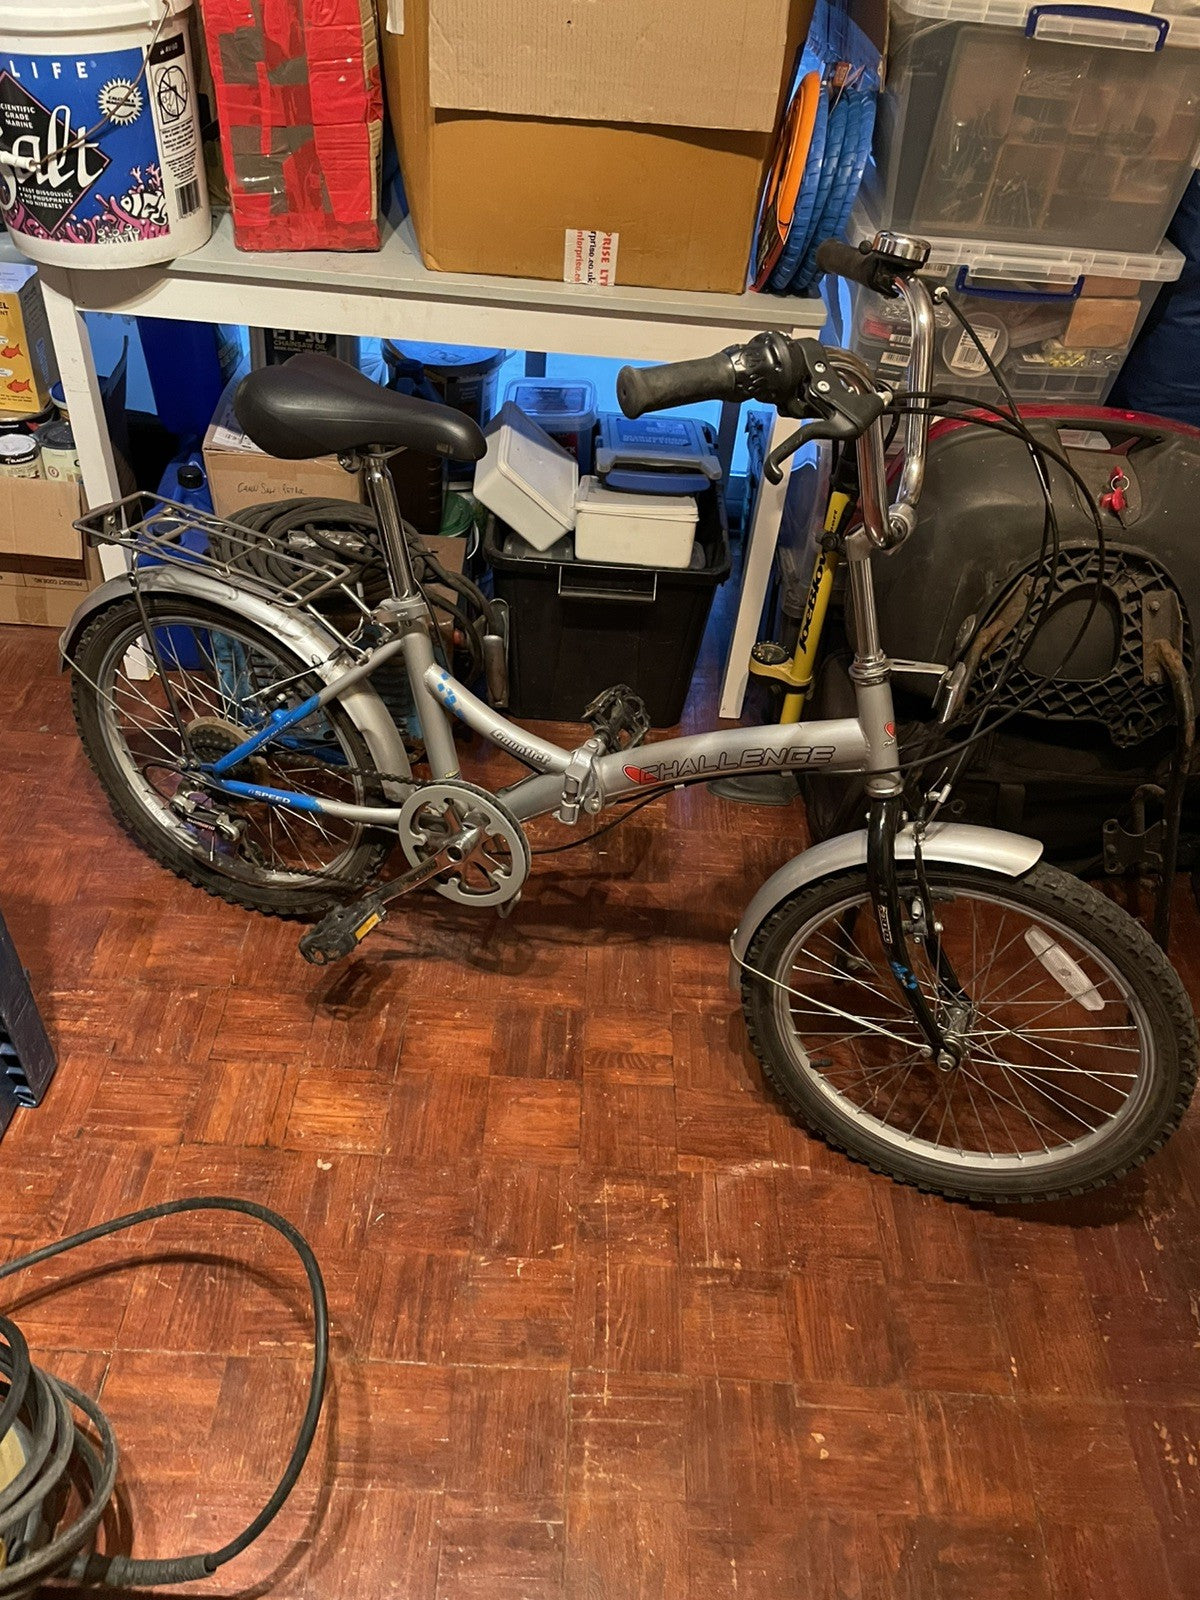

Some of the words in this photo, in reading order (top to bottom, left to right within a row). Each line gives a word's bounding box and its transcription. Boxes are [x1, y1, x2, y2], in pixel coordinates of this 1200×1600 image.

[9, 60, 88, 79] LIFE
[5, 111, 30, 121] GRADE
[5, 119, 33, 129] MARINE
[34, 200, 63, 210] NITRATES
[639, 745, 836, 785] CHALLENGE
